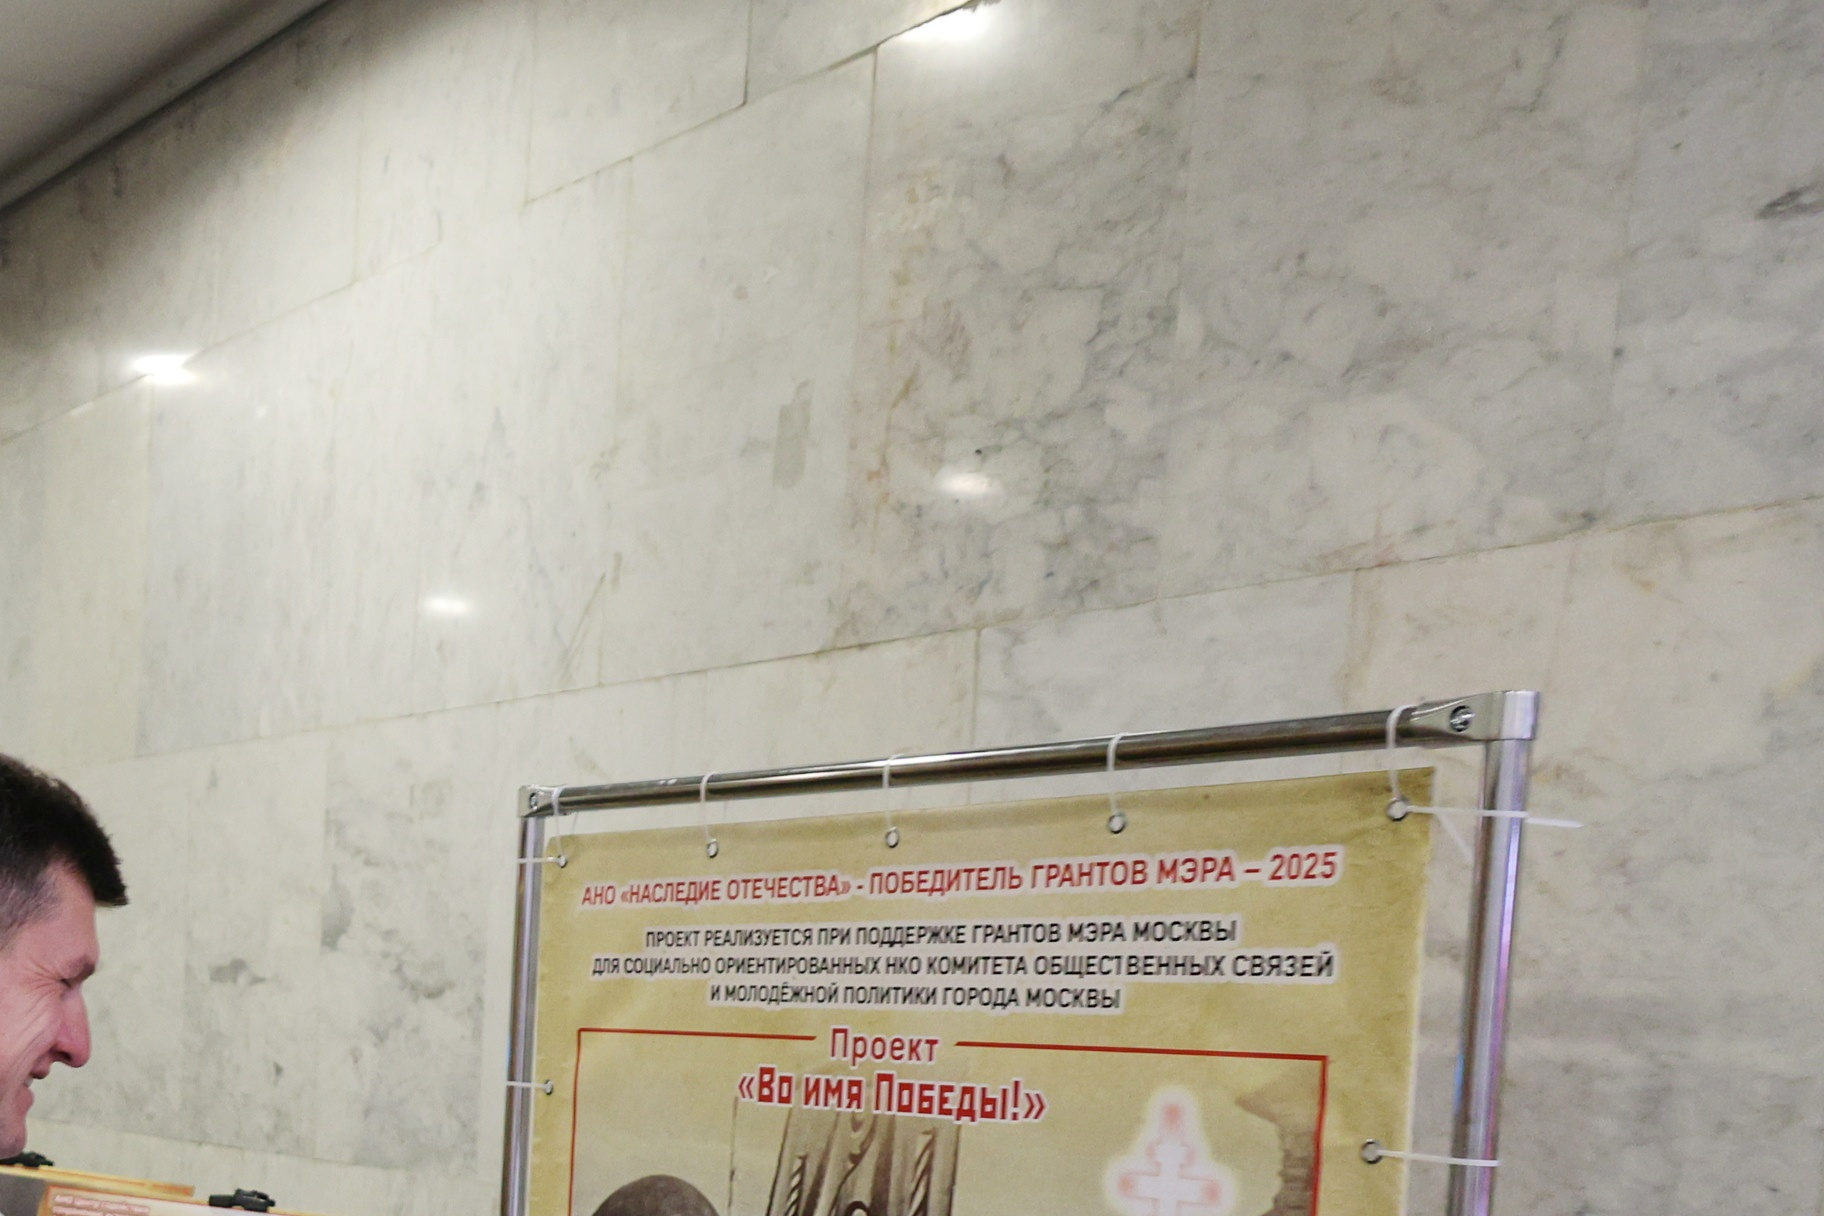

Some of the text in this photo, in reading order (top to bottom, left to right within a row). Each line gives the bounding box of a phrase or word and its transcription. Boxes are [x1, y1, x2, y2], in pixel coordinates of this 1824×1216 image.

[582, 886, 616, 905] АНО
[621, 879, 721, 905] «НАСЛЕДИЕ
[727, 874, 851, 900] ОТЕЧЕСТВА»
[870, 866, 1023, 896] ПОБЕДИТЕЛЬ
[1031, 860, 1148, 888] ГРАНТОВ
[1157, 856, 1234, 884] МЭРА
[1268, 852, 1338, 881] 2025
[646, 920, 1236, 947] ПРОЕКТ РЕАЛИЗУЕТСЯ ПРИ ПОДДЕРЖКЕ ГРАНТОВ МЭРА МОСКВЫ
[592, 951, 1334, 978] ДЛЯ СОЦИАЛЬНО ОРИЕНТИРОВАННЫХ НКО КОМИТЕТА ОБЩЕСТВЕННЫХ СВЯЗЕЙ
[711, 982, 1120, 1009] И МОЛОДЁЖНОЙ ПОЛИТИКИ ГОРОДА МОСКВЫ
[832, 1028, 939, 1066] Проект
[738, 1067, 1046, 1122] «Во имя Победы!»
